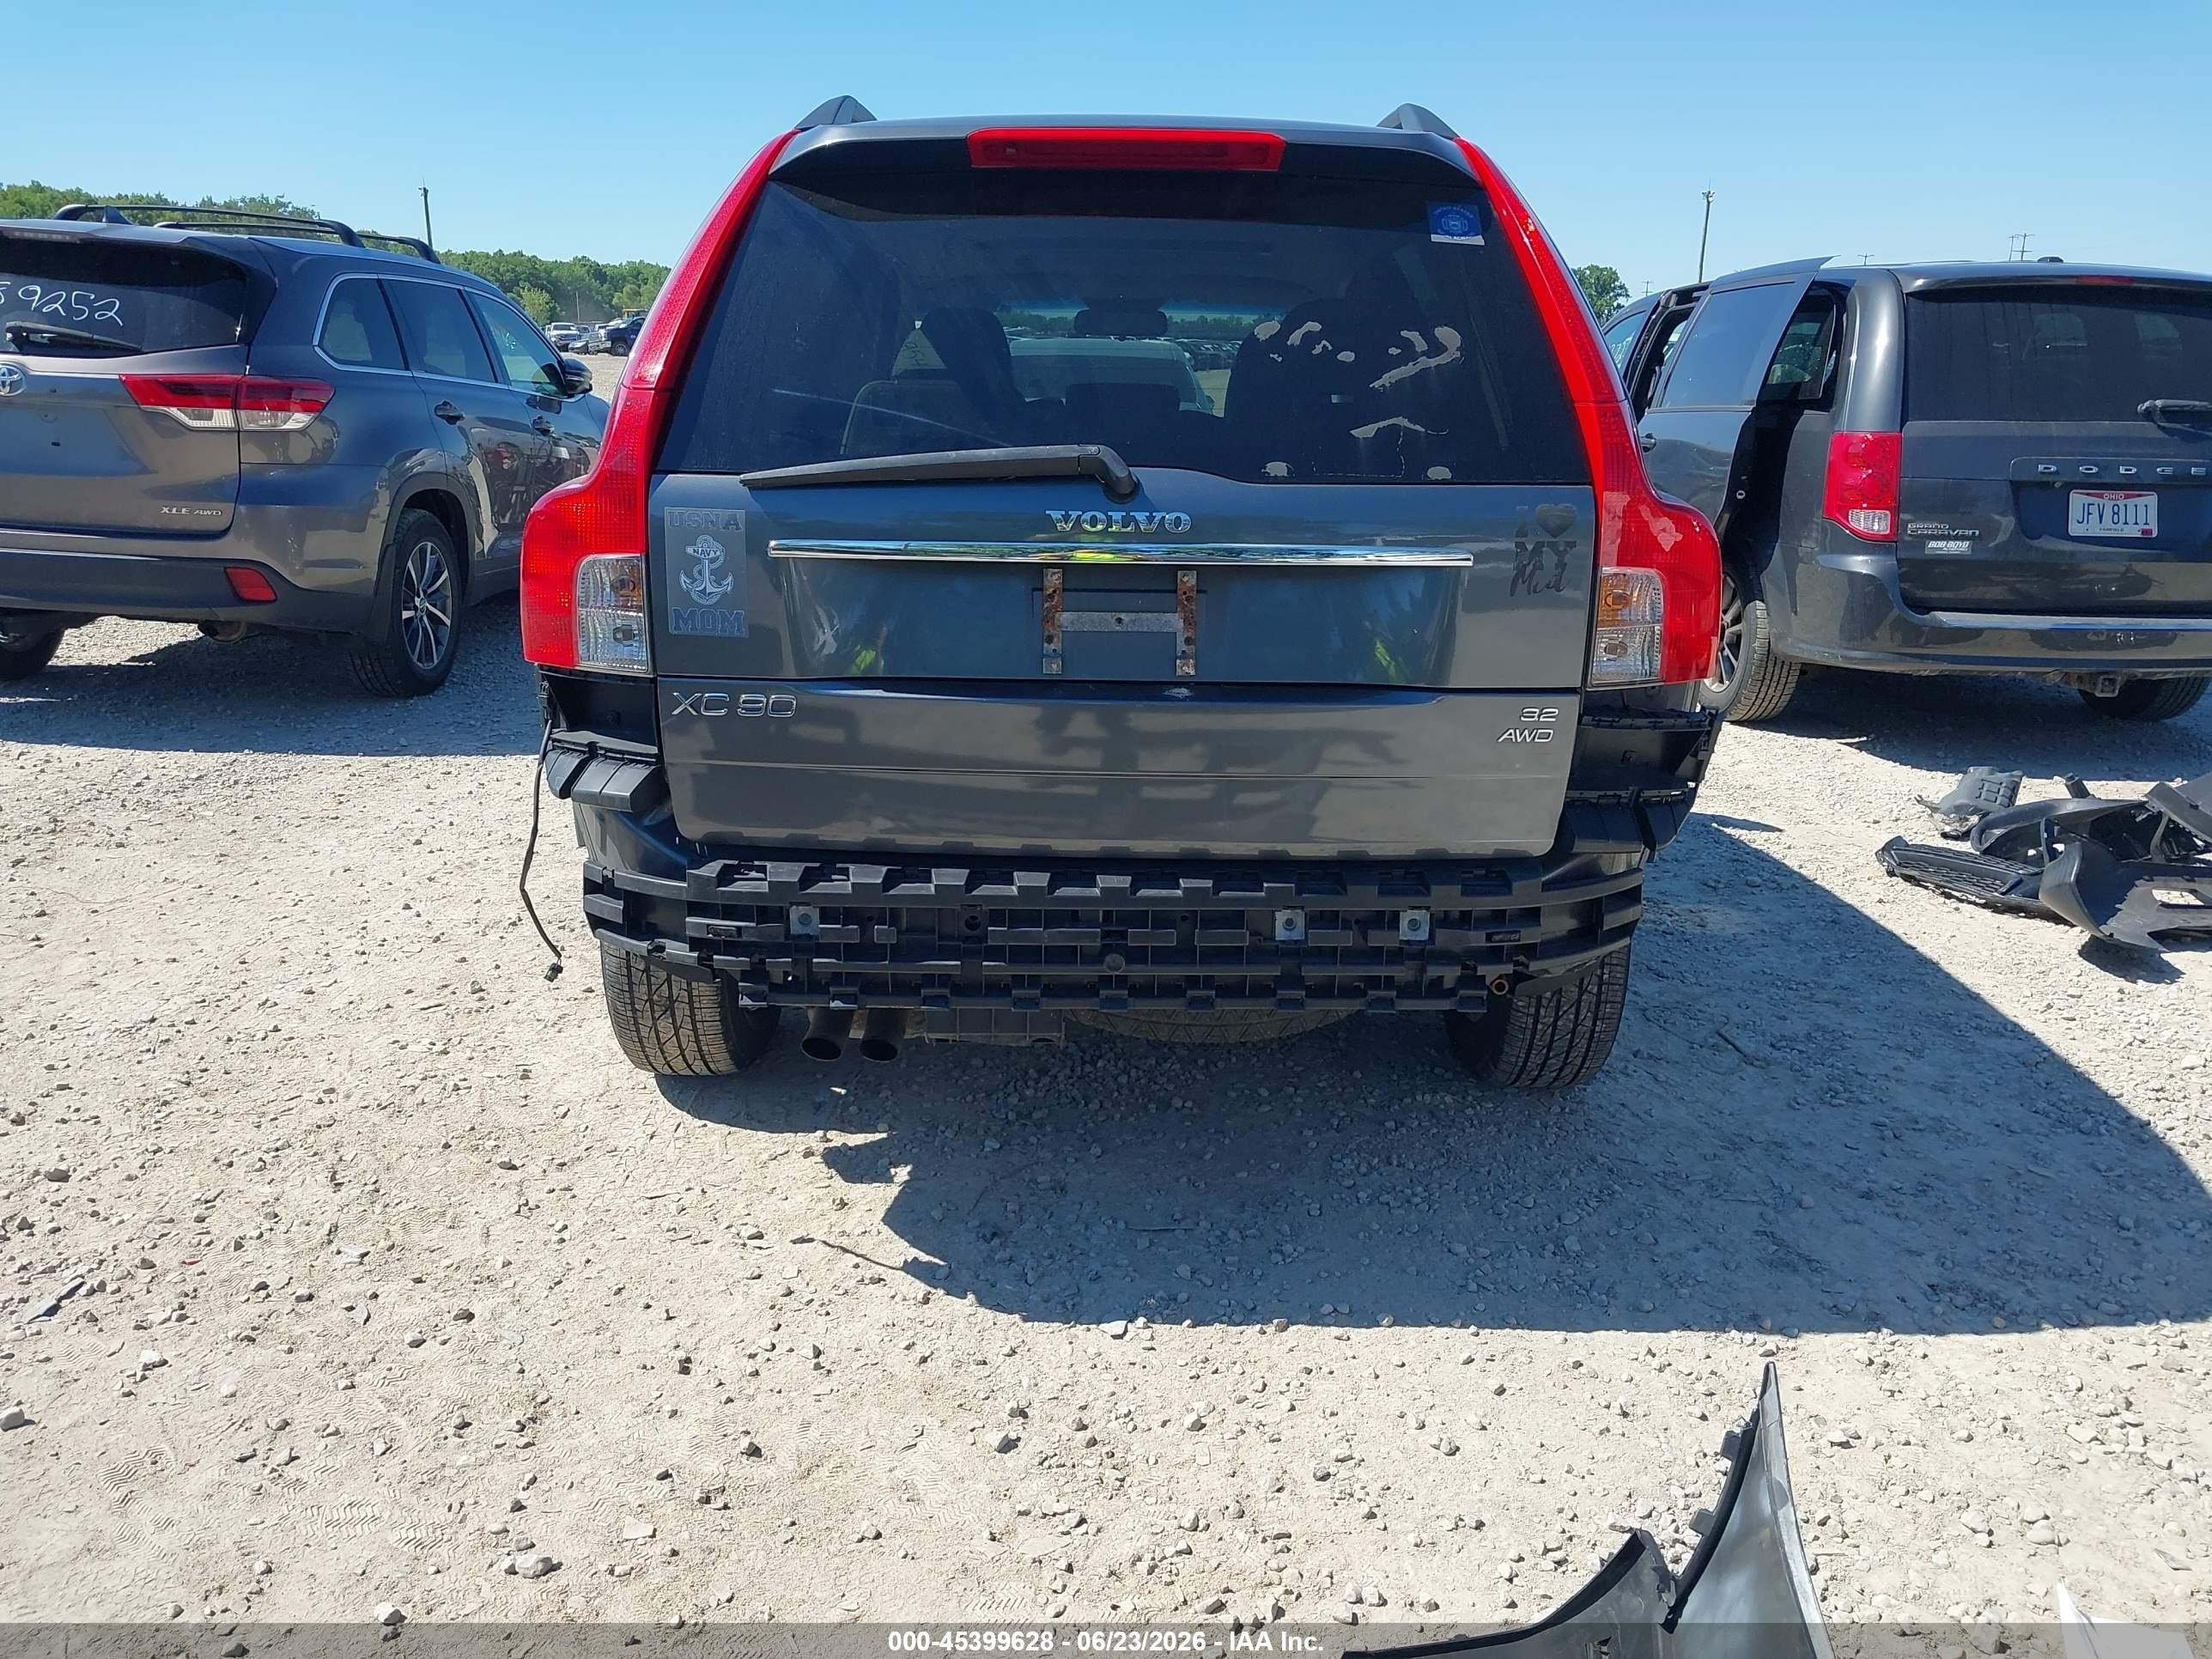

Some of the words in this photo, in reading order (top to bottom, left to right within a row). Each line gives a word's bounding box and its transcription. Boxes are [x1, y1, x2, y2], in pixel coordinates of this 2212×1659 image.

[2038, 464, 2207, 477] DODGE
[2103, 492, 2125, 501] OHIO
[669, 511, 743, 532] USNA
[1045, 510, 1192, 533] VOLVO
[2076, 501, 2106, 526] JFV
[2111, 502, 2150, 526] 8111
[1513, 541, 1577, 571] MY
[672, 607, 744, 635] MOM
[672, 692, 730, 716] XC
[737, 694, 797, 718] 90
[1497, 728, 1554, 743] AWD
